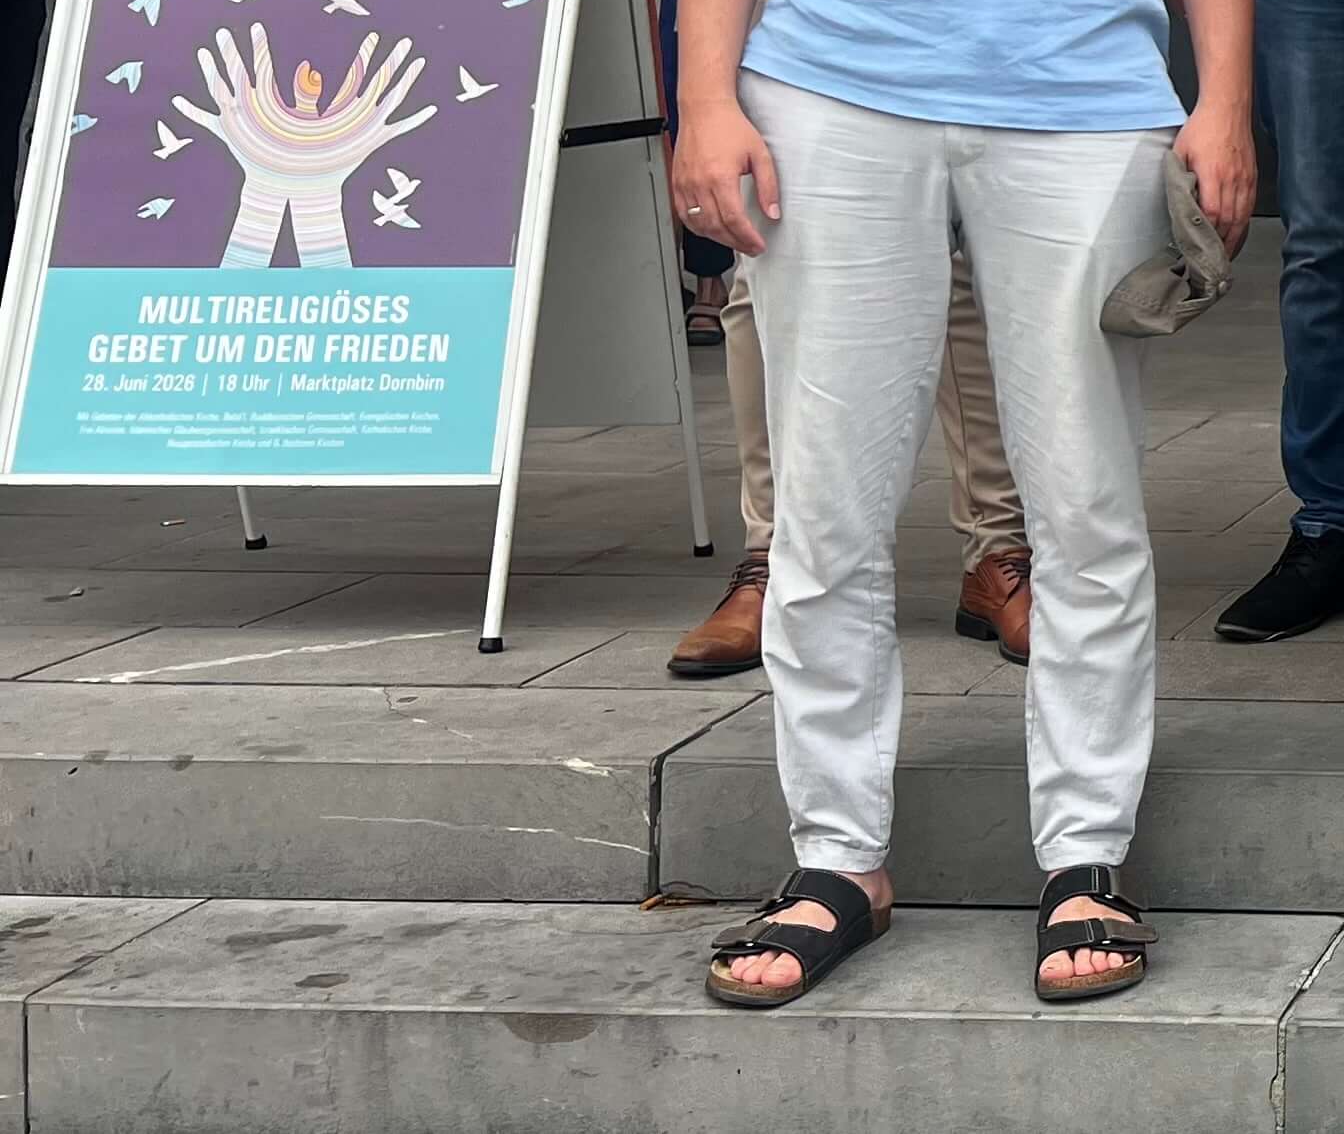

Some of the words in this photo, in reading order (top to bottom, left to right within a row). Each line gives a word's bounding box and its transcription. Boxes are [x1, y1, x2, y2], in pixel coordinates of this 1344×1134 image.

[138, 289, 410, 324] MULTIRELIGIÖSES
[88, 333, 189, 363] GEBET
[195, 334, 246, 363] UM
[253, 334, 316, 363] DEN
[323, 334, 450, 363] FRIEDEN
[81, 373, 108, 392] 28.
[113, 373, 149, 392] Juni
[151, 373, 196, 392] 2026
[218, 373, 238, 392] 18
[242, 373, 271, 392] Uhr
[290, 373, 375, 395] Marktplatz
[379, 373, 445, 392] Dornbirn
